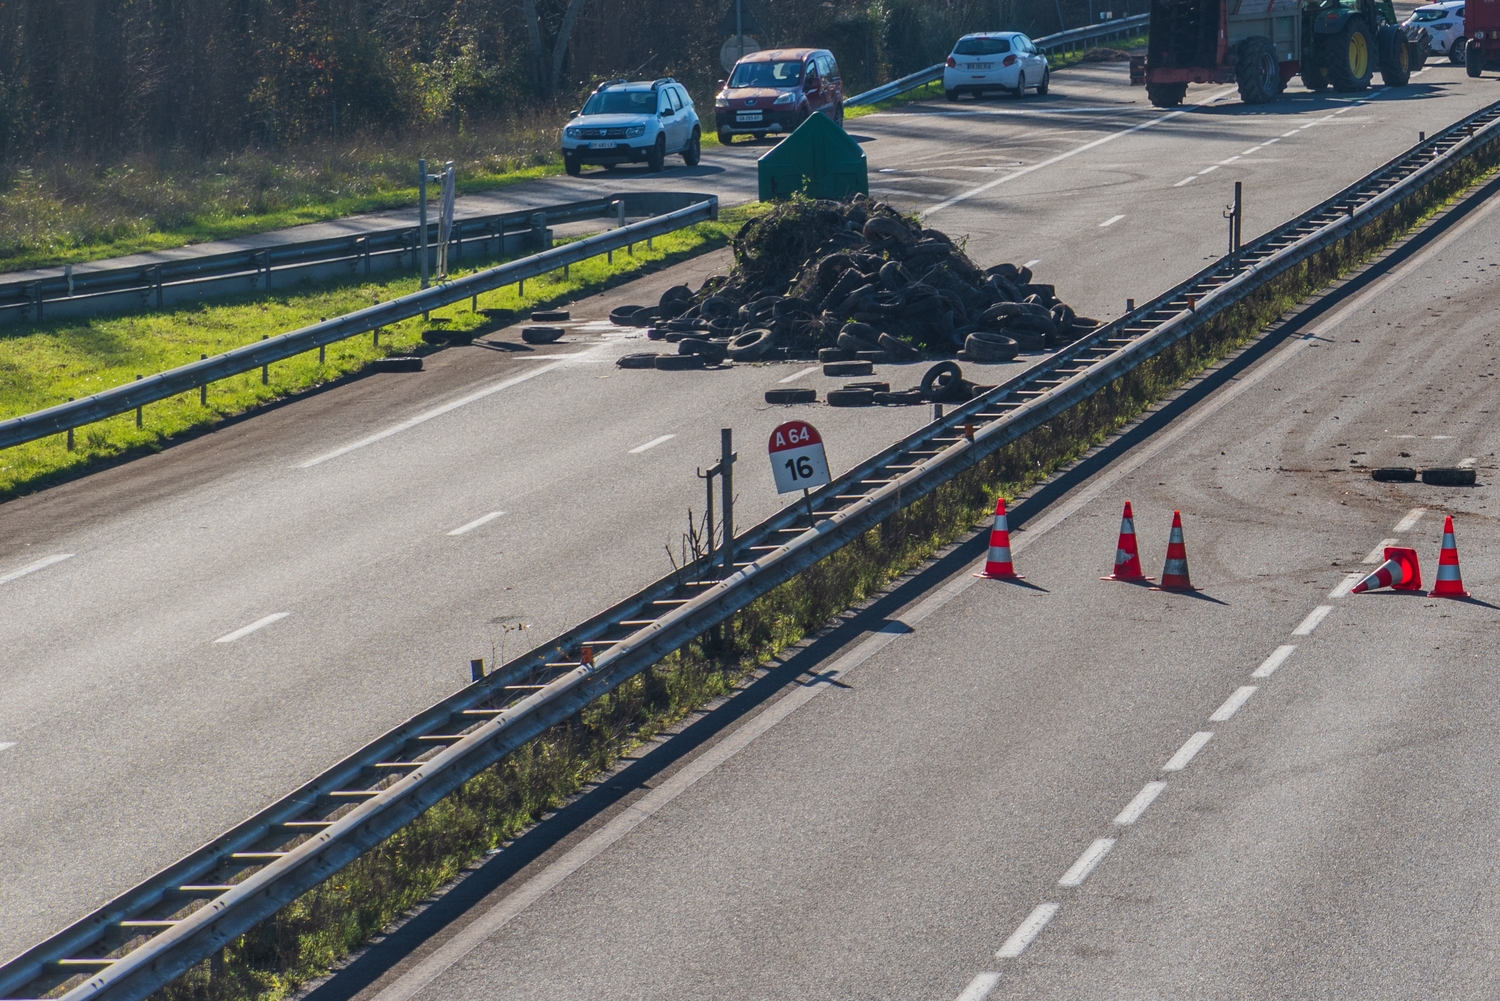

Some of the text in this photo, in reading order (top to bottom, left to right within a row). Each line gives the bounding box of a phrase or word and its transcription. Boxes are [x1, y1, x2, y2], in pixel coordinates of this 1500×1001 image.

[775, 426, 810, 447] A 64
[784, 455, 814, 481] 16
